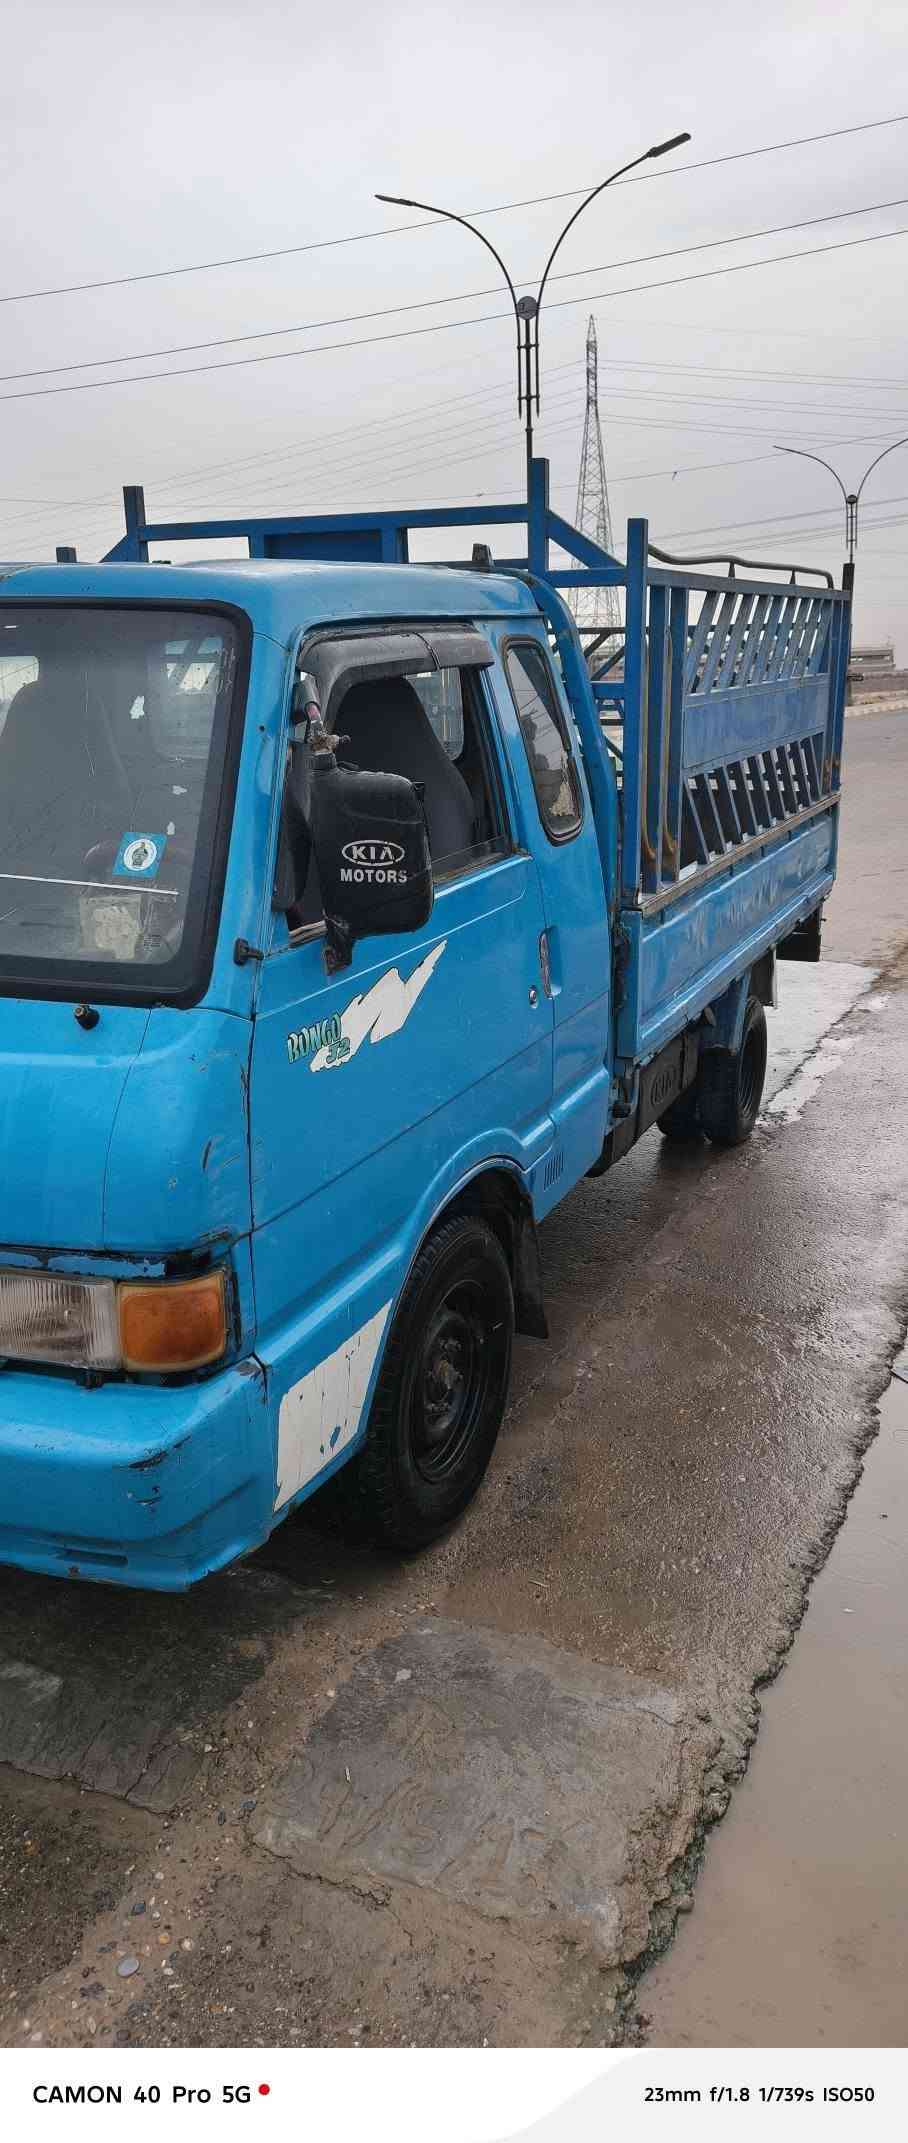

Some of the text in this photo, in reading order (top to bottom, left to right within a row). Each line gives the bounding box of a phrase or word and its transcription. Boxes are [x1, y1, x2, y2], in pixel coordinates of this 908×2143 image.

[352, 846, 394, 860] KIA
[340, 868, 407, 883] MOTORS
[288, 1010, 341, 1064] BONGO
[326, 1037, 350, 1064] J2
